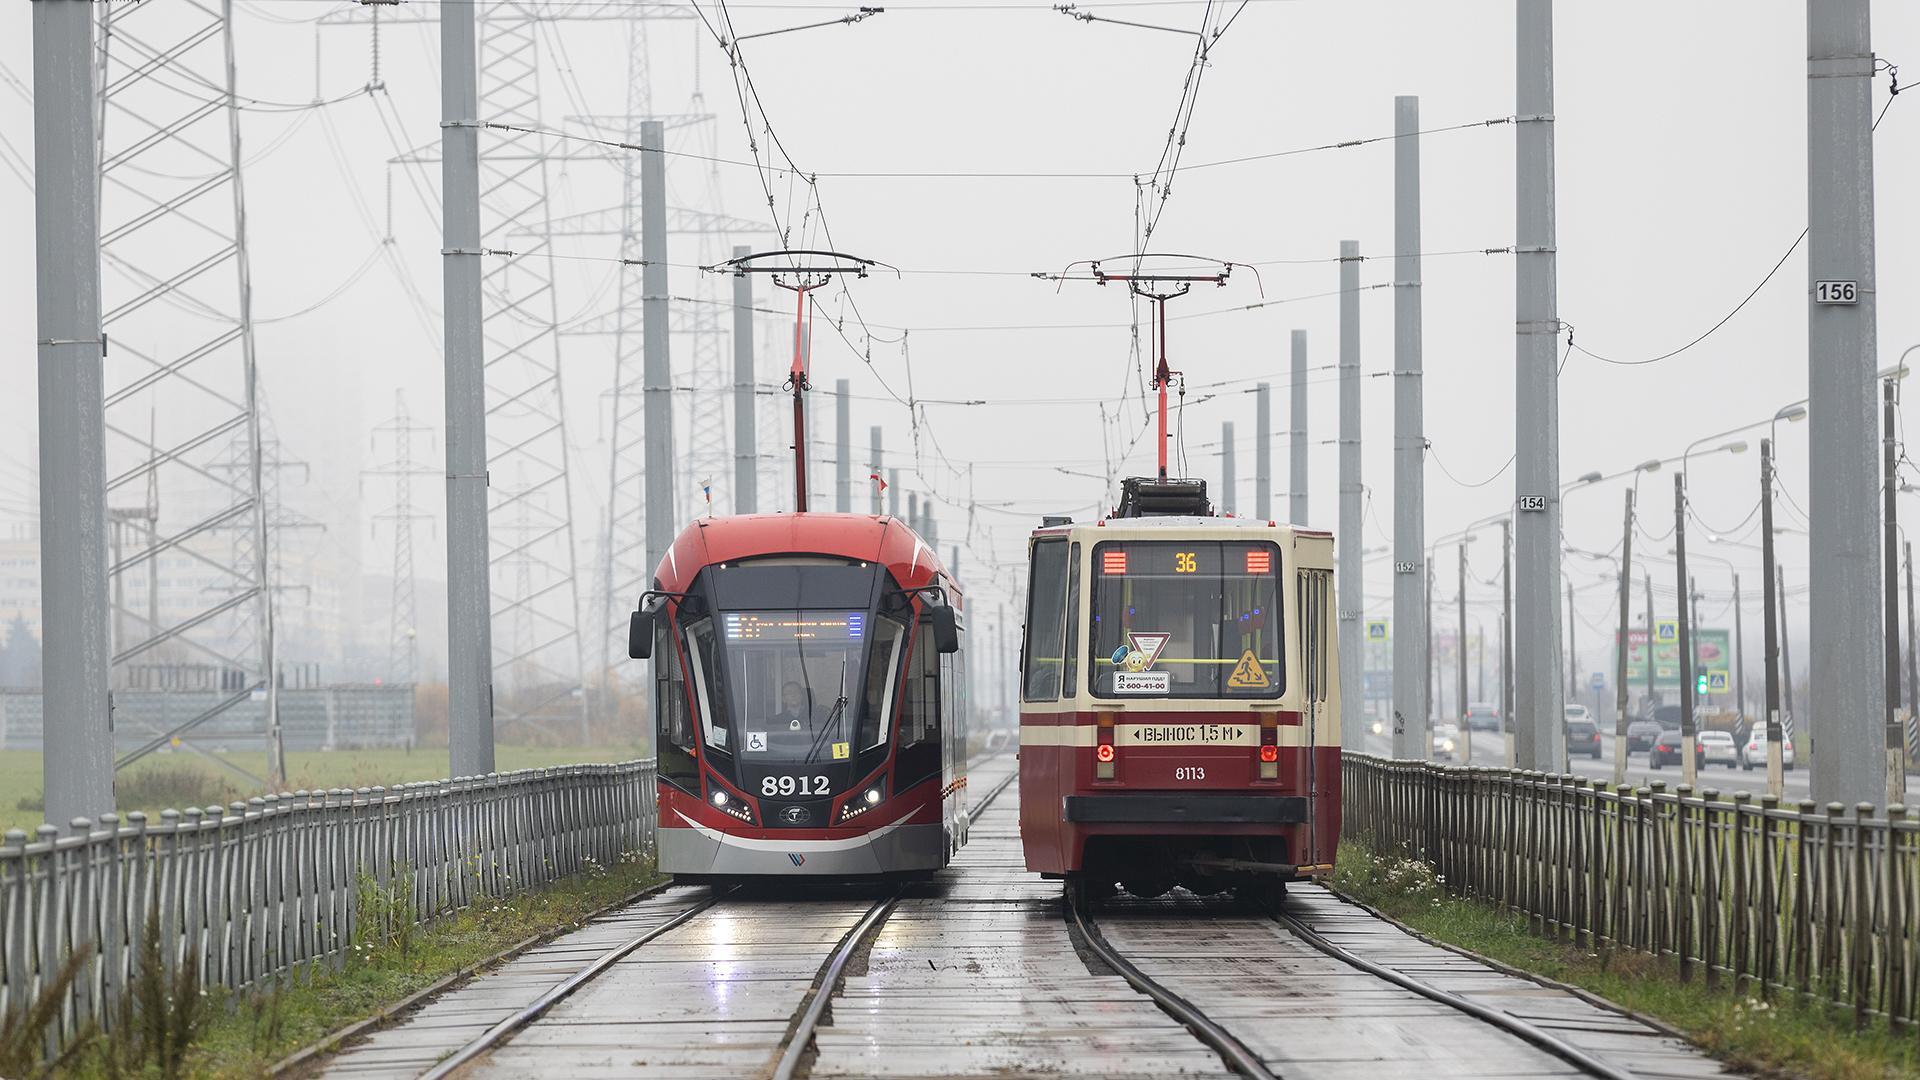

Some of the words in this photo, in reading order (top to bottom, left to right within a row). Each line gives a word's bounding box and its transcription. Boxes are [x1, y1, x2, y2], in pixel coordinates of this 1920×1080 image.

[1819, 283, 1855, 300] 156
[1521, 497, 1544, 509] 154
[1175, 552, 1197, 573] 36
[1397, 562, 1414, 571] 152
[1144, 728, 1195, 741] ВЫНОС
[1200, 725, 1218, 743] 1,5
[1223, 727, 1233, 740] М
[1175, 767, 1205, 780] 8113
[761, 775, 831, 796] 8912
